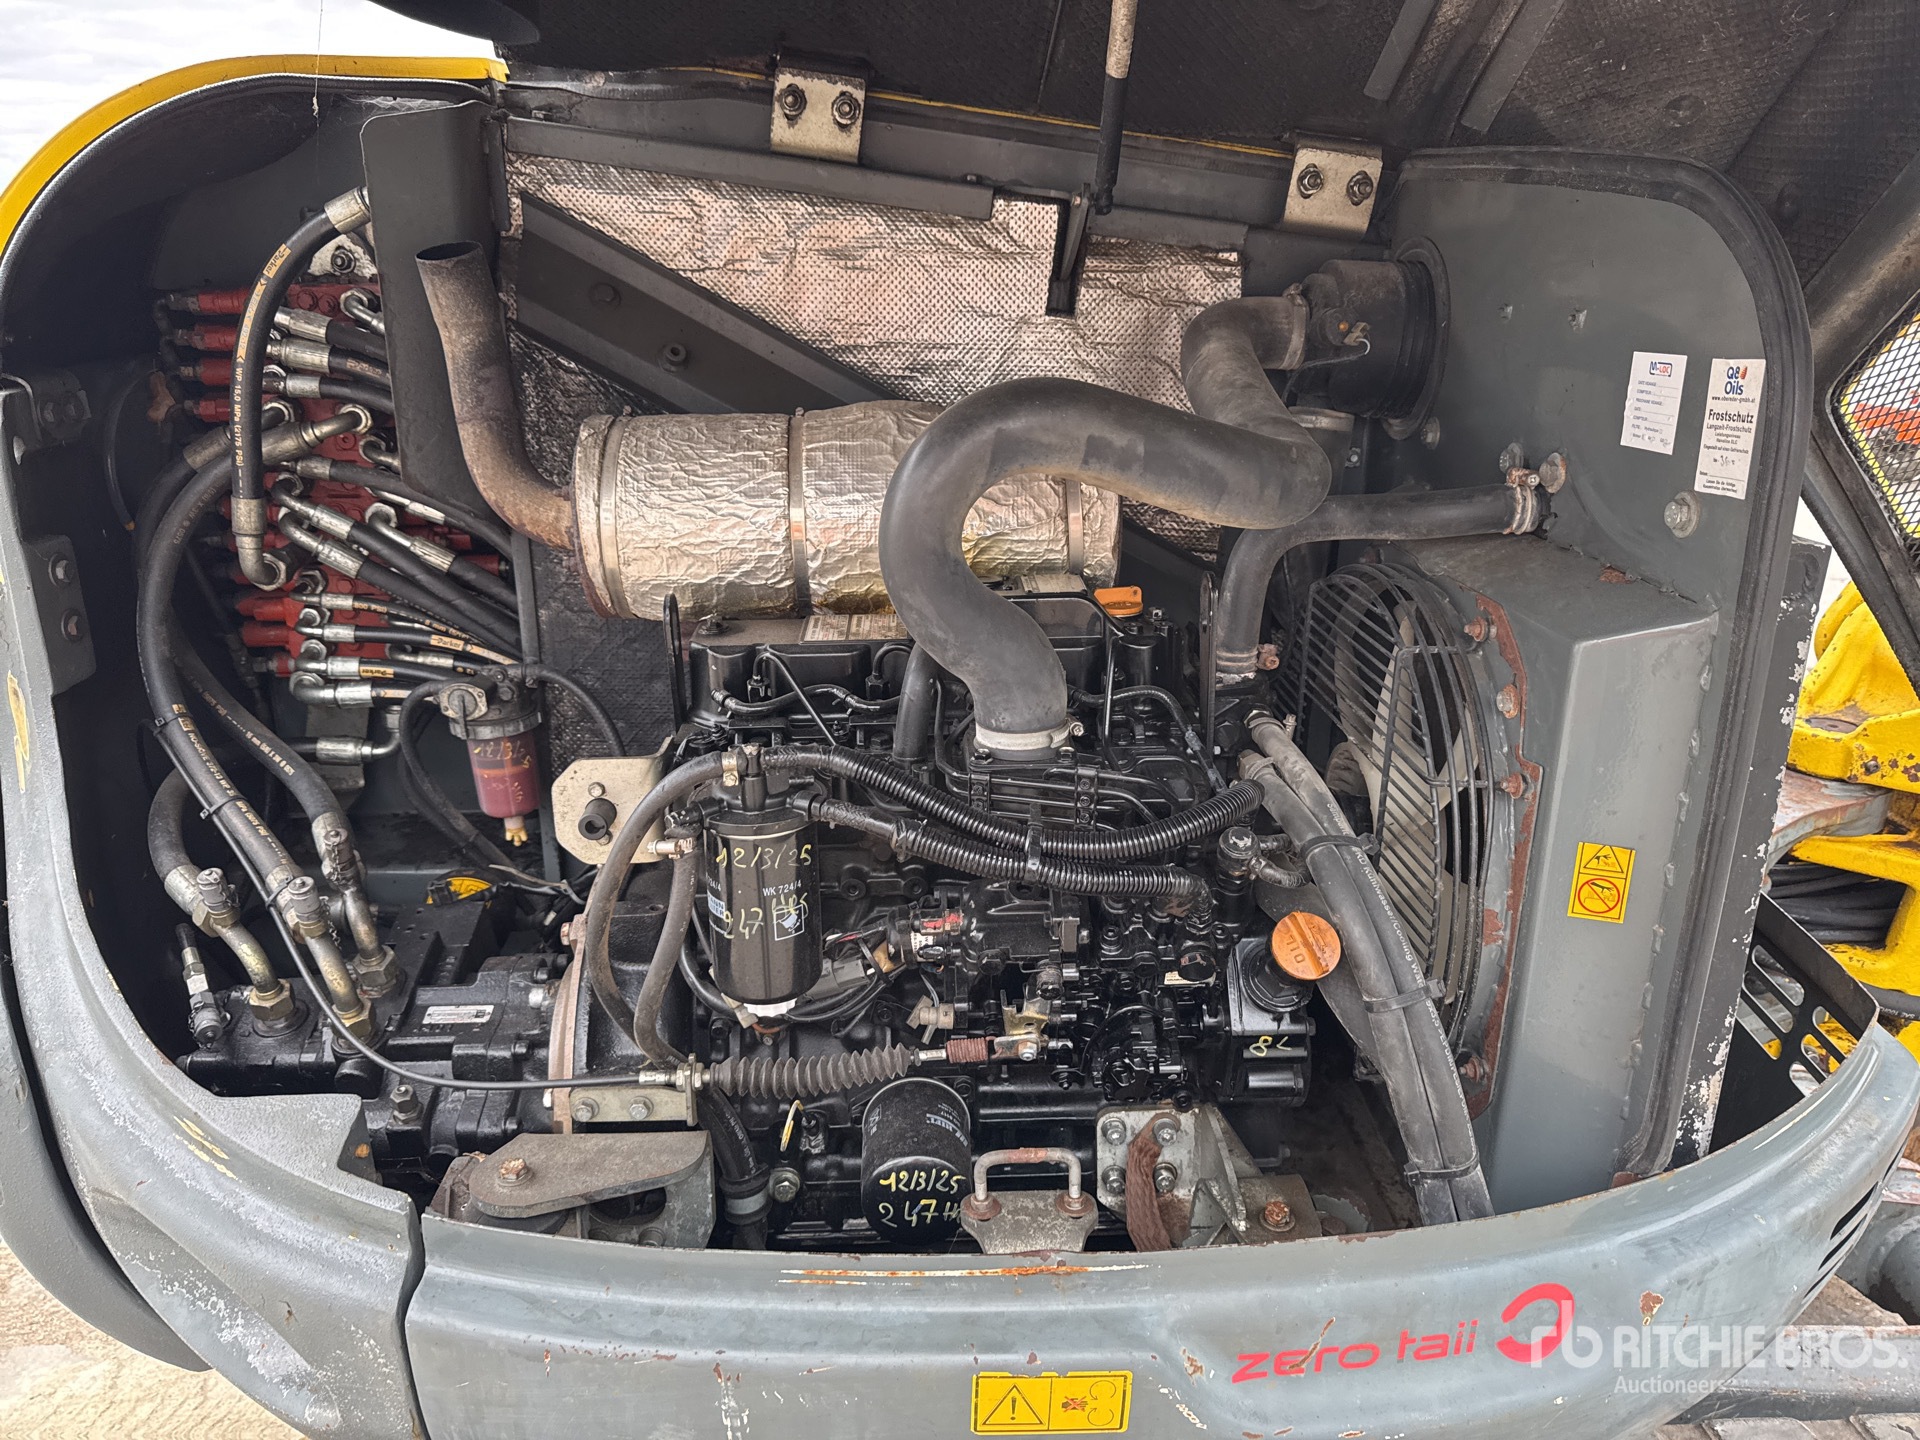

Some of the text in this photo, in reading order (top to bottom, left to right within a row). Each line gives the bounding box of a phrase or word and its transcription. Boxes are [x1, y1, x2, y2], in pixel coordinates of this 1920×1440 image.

[266, 247, 286, 275] Parker
[235, 367, 242, 382] WP
[1727, 366, 1740, 379] Q8
[1724, 381, 1744, 395] Oils
[1708, 409, 1754, 423] Frostschutz
[234, 425, 242, 447] (2175
[1707, 423, 1752, 433] Langzeit-Frostschutz
[434, 637, 461, 648] Parker
[361, 668, 387, 677] Parker
[716, 843, 812, 869] 12/3/25
[763, 880, 802, 897] WK 724/4
[1286, 935, 1306, 964] OIL
[879, 1168, 967, 1195] 12/3/25
[878, 1199, 939, 1228] 247
[1231, 1342, 1381, 1385] zero
